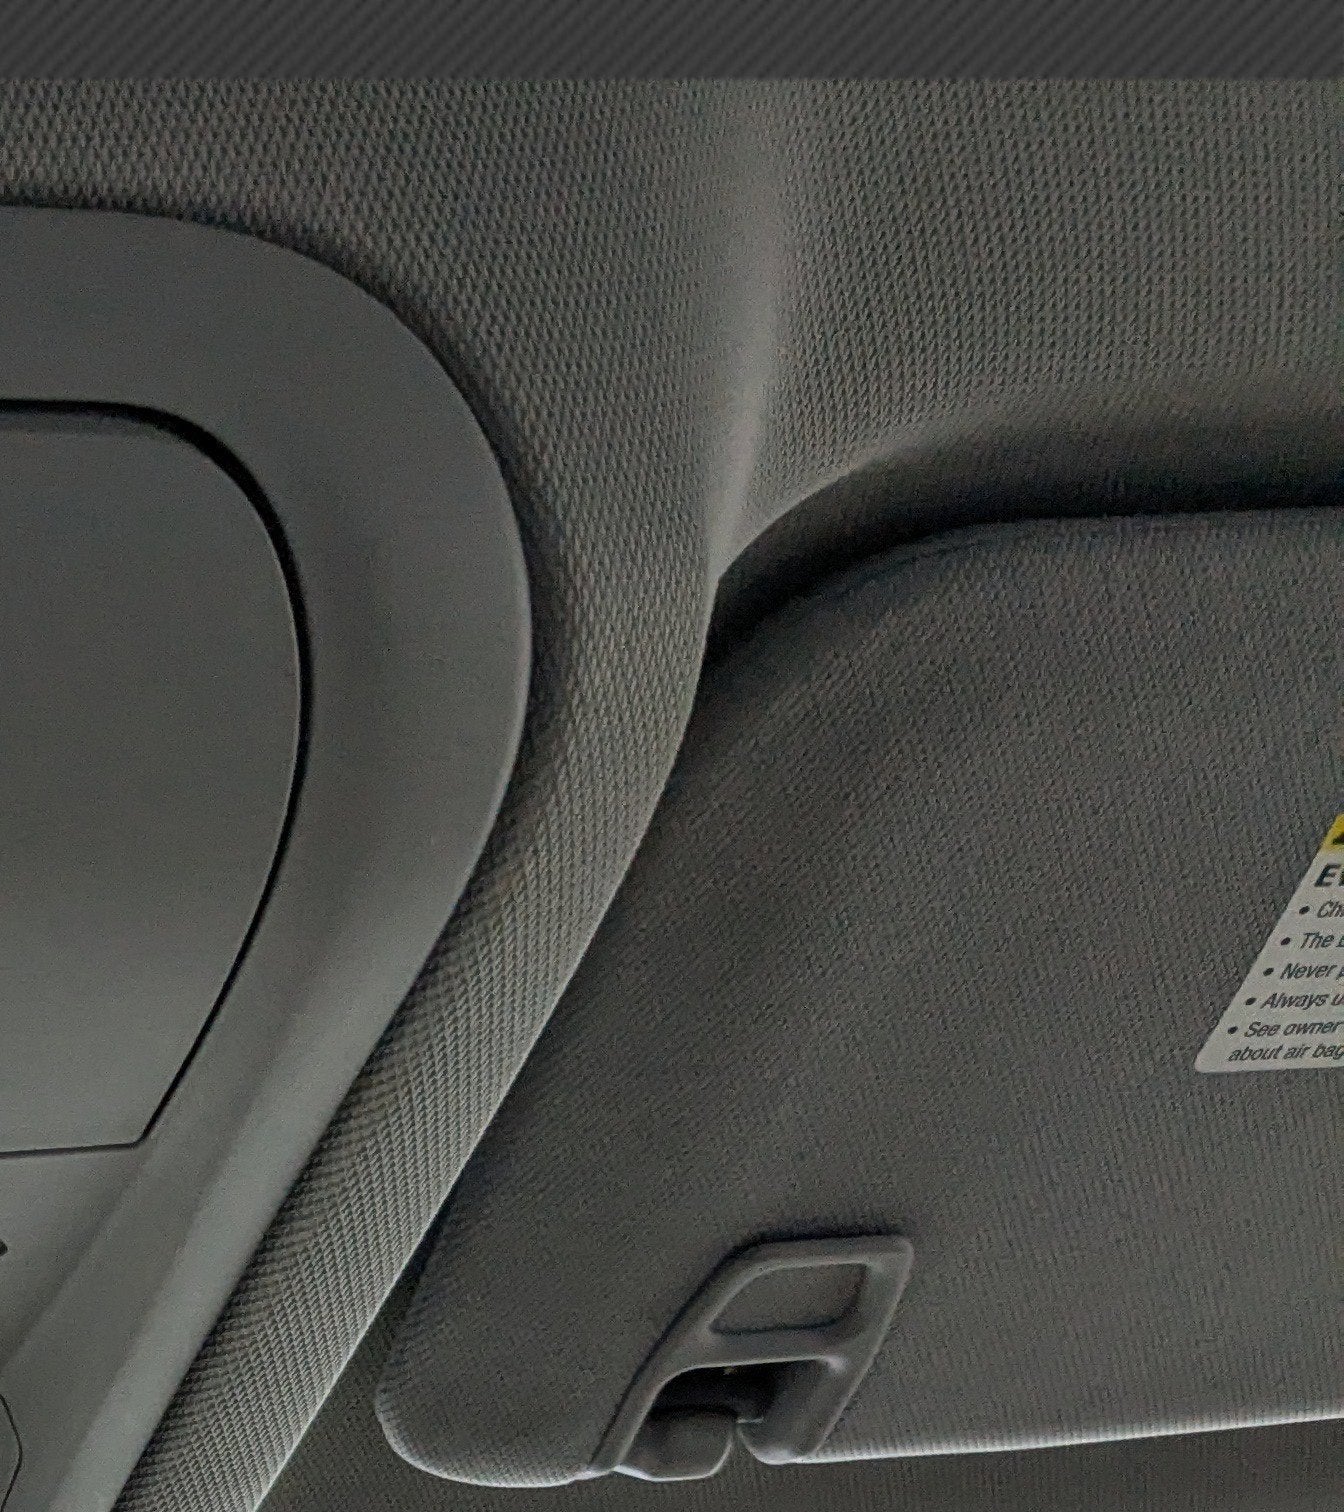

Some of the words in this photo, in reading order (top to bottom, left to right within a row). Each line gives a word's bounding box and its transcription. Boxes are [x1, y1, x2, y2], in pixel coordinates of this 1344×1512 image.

[1300, 931, 1335, 949] The
[1280, 962, 1337, 980] Never
[1260, 992, 1330, 1010] Always
[1244, 1021, 1281, 1037] See
[1228, 1044, 1283, 1061] about
[1283, 1044, 1311, 1060] air
